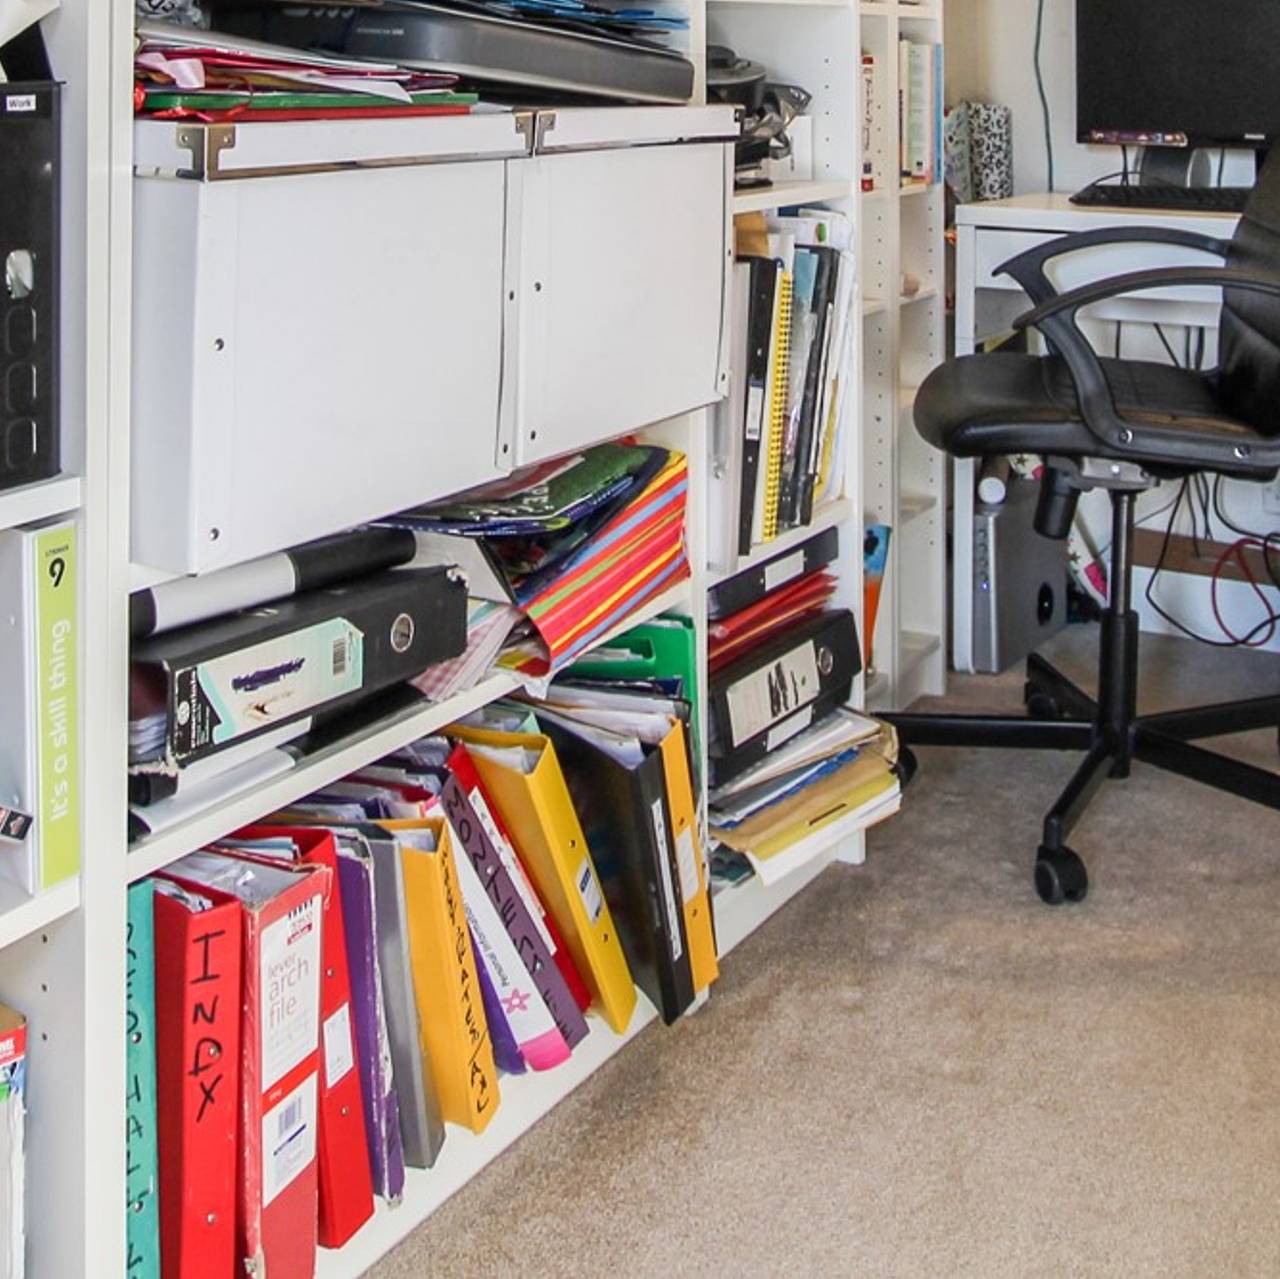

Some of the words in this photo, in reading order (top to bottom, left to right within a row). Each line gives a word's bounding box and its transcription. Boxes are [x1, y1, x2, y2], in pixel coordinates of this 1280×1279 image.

[8, 99, 33, 110] Work
[49, 619, 72, 691] thing
[49, 696, 68, 748] skill
[50, 779, 68, 822] It's
[270, 995, 297, 1030] file
